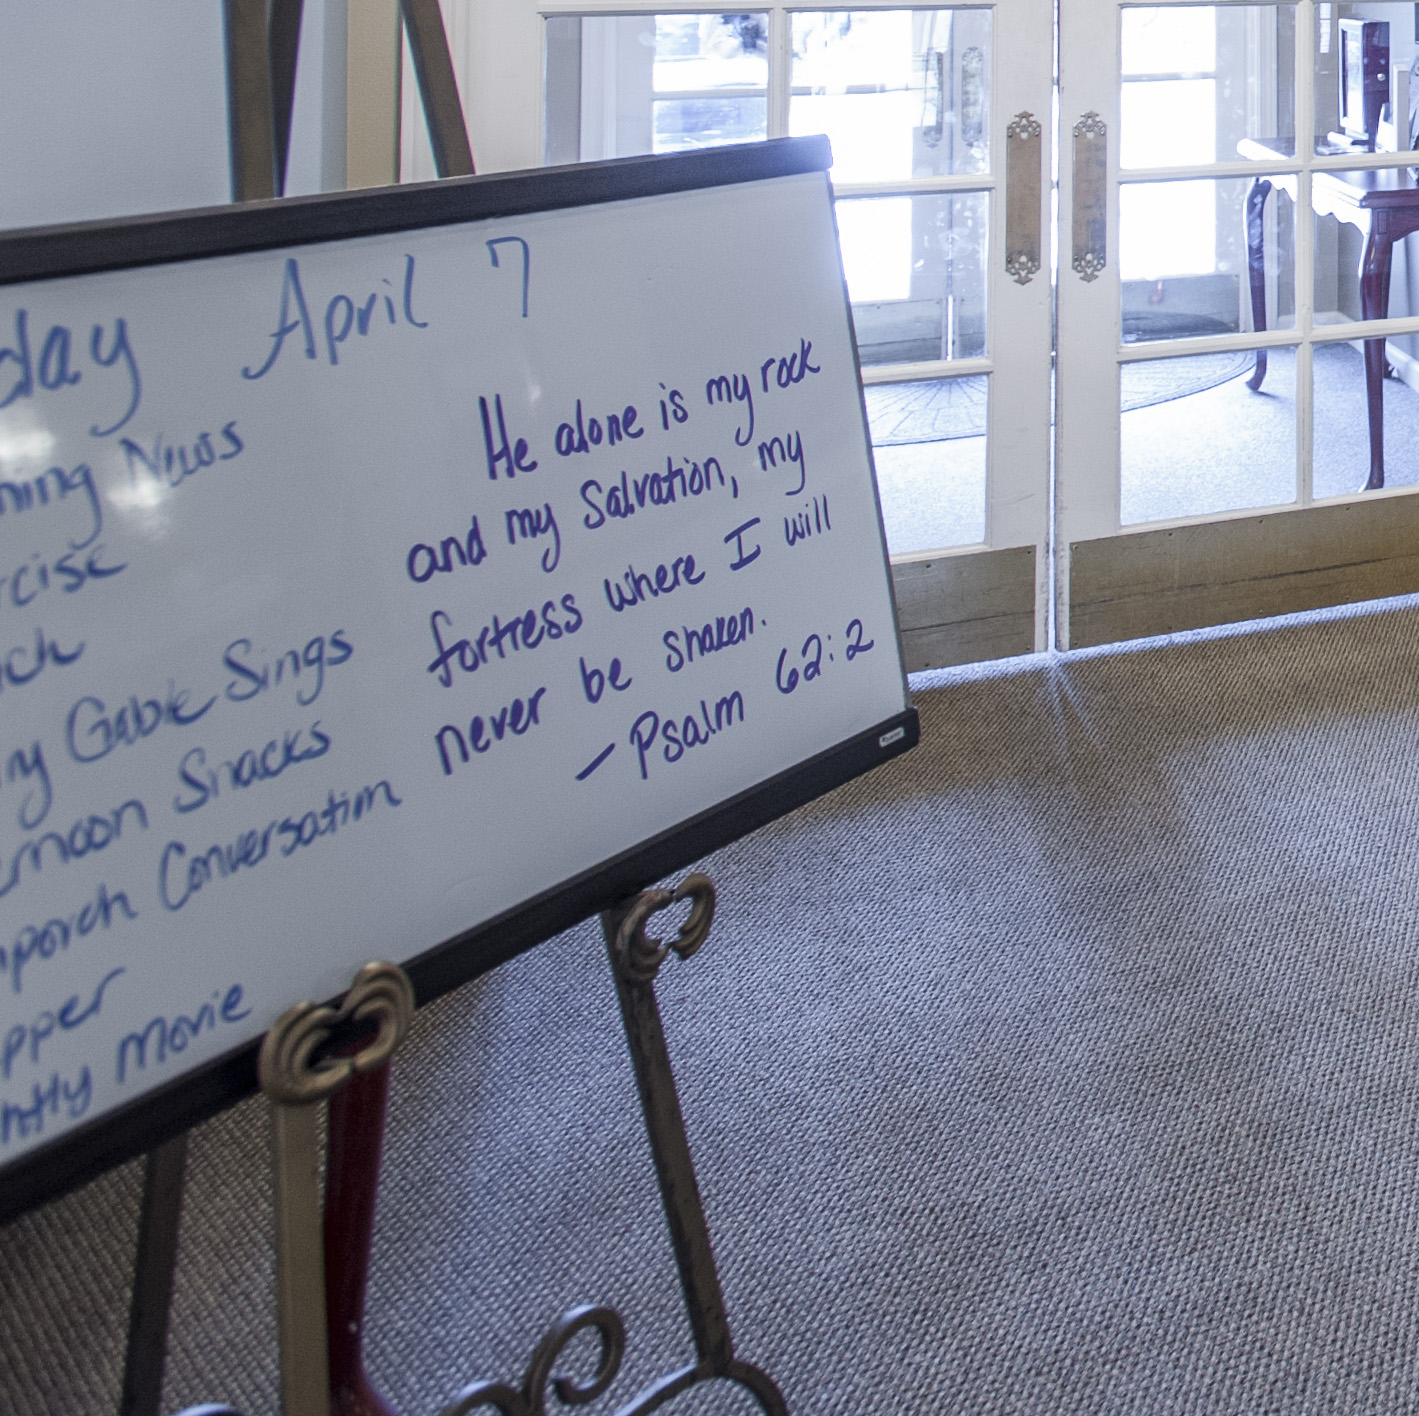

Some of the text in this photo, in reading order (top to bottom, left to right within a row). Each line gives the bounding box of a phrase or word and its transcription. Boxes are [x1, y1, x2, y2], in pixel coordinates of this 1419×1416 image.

[241, 254, 429, 380] April
[486, 236, 530, 319] 7
[479, 336, 822, 481] He alone is my rock
[407, 515, 488, 583] and
[504, 502, 561, 573] my
[757, 430, 806, 496] my
[427, 493, 832, 689] fortress where I will
[774, 617, 875, 695] 62:2
[222, 629, 354, 706] Sings
[434, 686, 547, 776] never
[578, 654, 633, 704] be
[173, 719, 332, 815] Snacks
